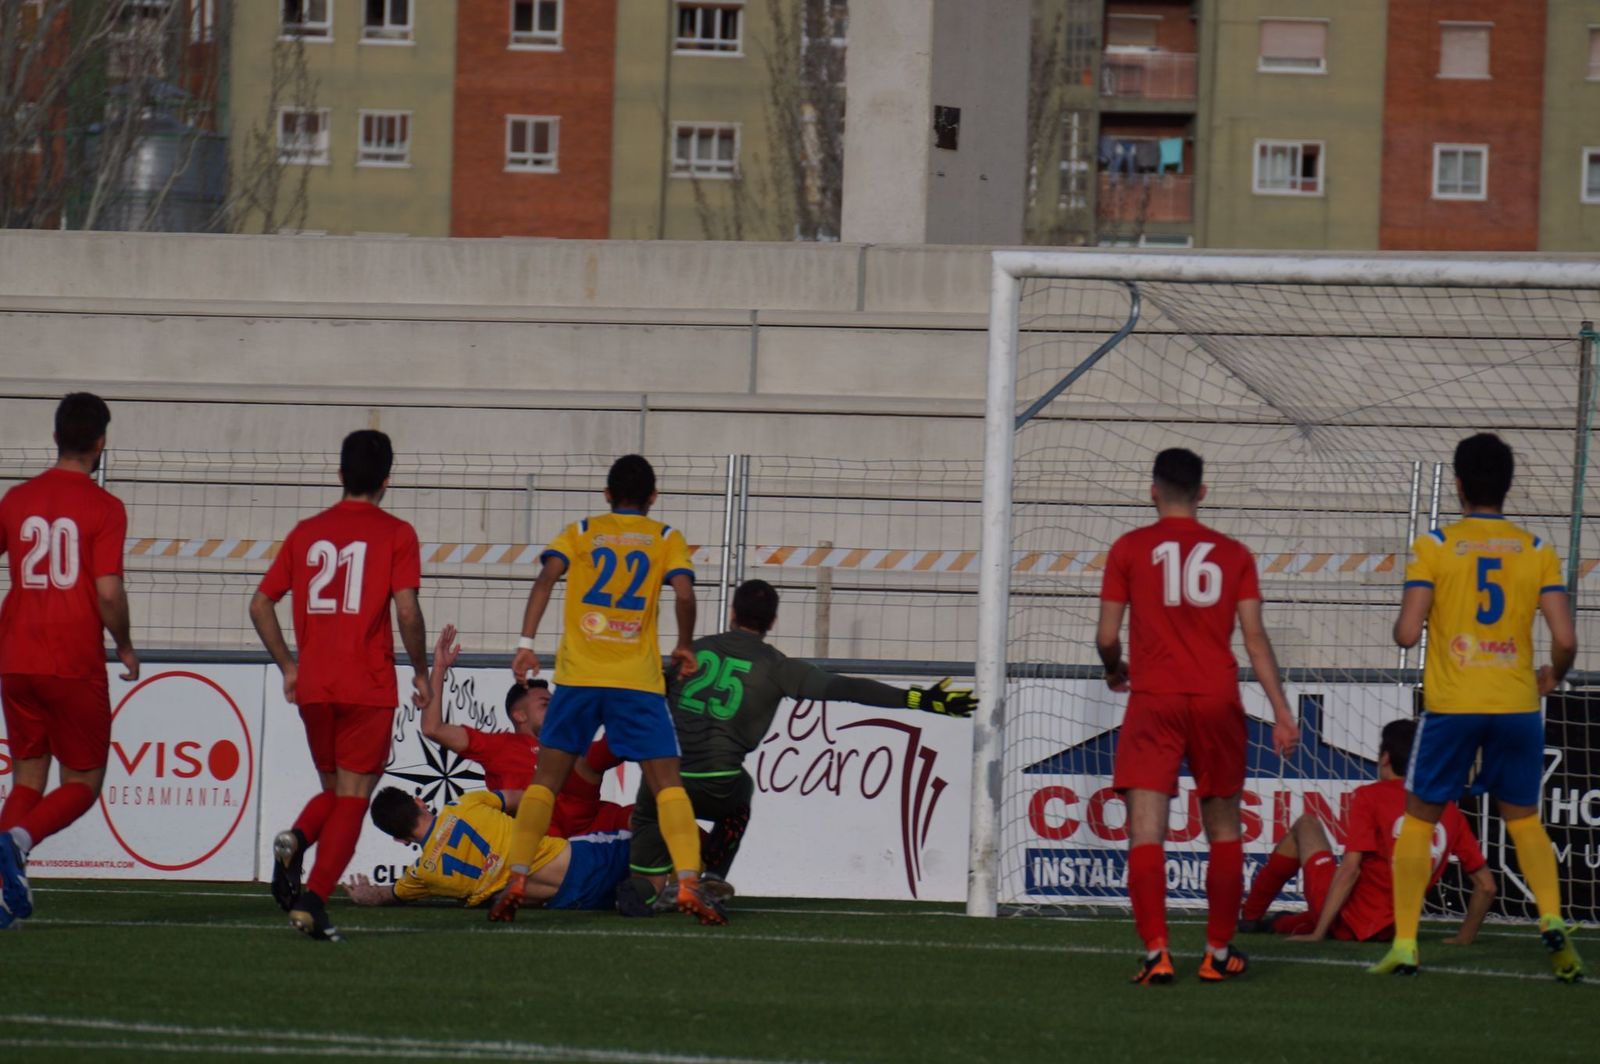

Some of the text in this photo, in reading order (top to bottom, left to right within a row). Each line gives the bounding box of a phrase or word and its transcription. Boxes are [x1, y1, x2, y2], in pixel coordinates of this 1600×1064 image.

[20, 515, 80, 589] 20
[307, 540, 367, 614] 21
[582, 547, 650, 610] 22
[1152, 541, 1222, 607] 16
[1476, 556, 1505, 625] 5
[678, 650, 752, 720] 25
[110, 739, 240, 781] VISO
[109, 785, 231, 807] DESAMIANTA
[442, 818, 491, 880] 17
